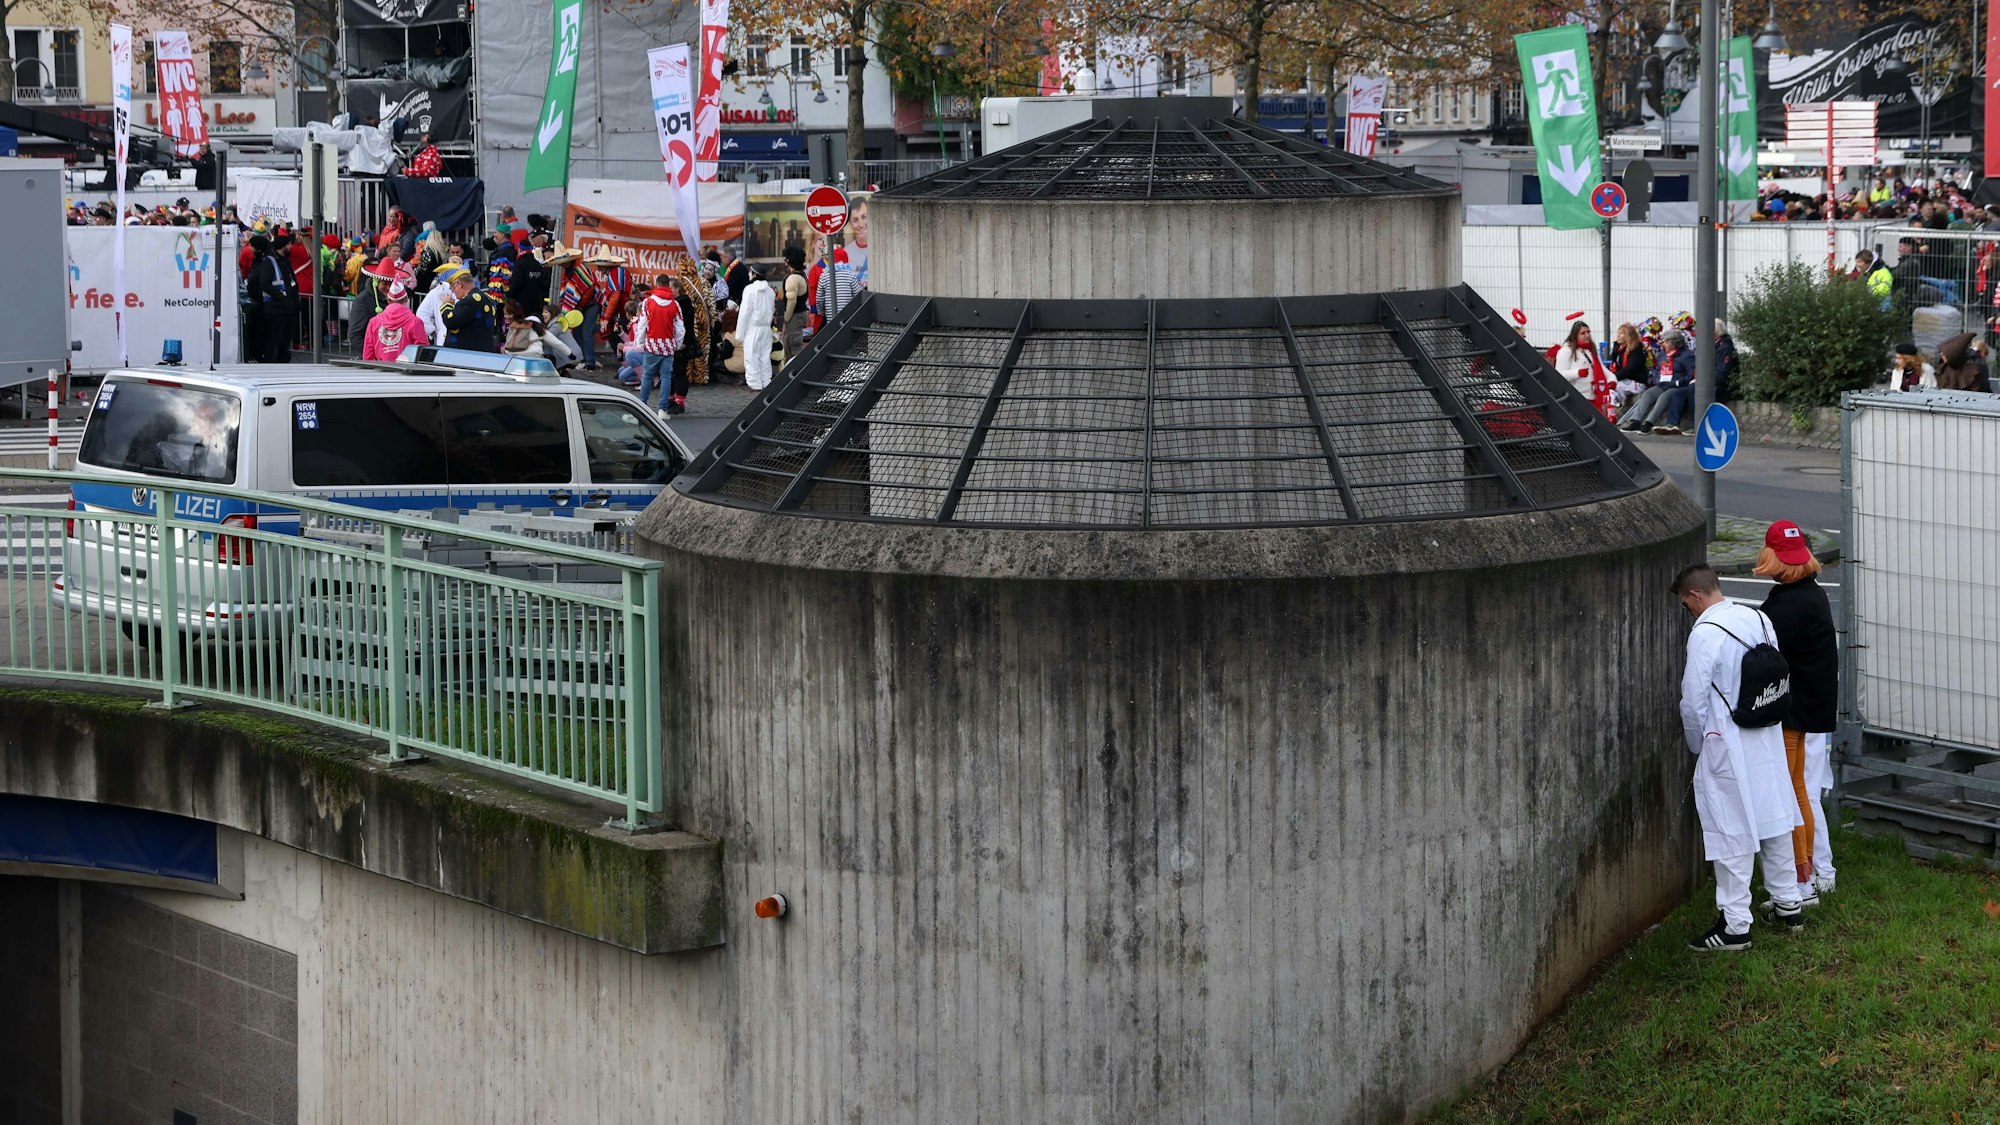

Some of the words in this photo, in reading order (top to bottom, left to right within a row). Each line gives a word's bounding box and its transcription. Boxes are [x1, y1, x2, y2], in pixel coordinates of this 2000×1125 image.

[1782, 71, 1832, 104] Willi
[1834, 28, 1938, 88] Ostermann
[160, 61, 197, 93] WC
[215, 102, 256, 125] Loco
[1350, 116, 1375, 156] WC
[1612, 138, 1660, 148] Markmannsgasse
[252, 203, 288, 219] @wdrjeck
[84, 287, 145, 309] fiee.
[164, 298, 216, 308] NetCologn
[102, 384, 117, 392] NRW
[99, 392, 113, 401] 2654
[296, 402, 316, 411] NRW
[298, 411, 317, 420] 2654
[149, 488, 221, 520] PLIZEI
